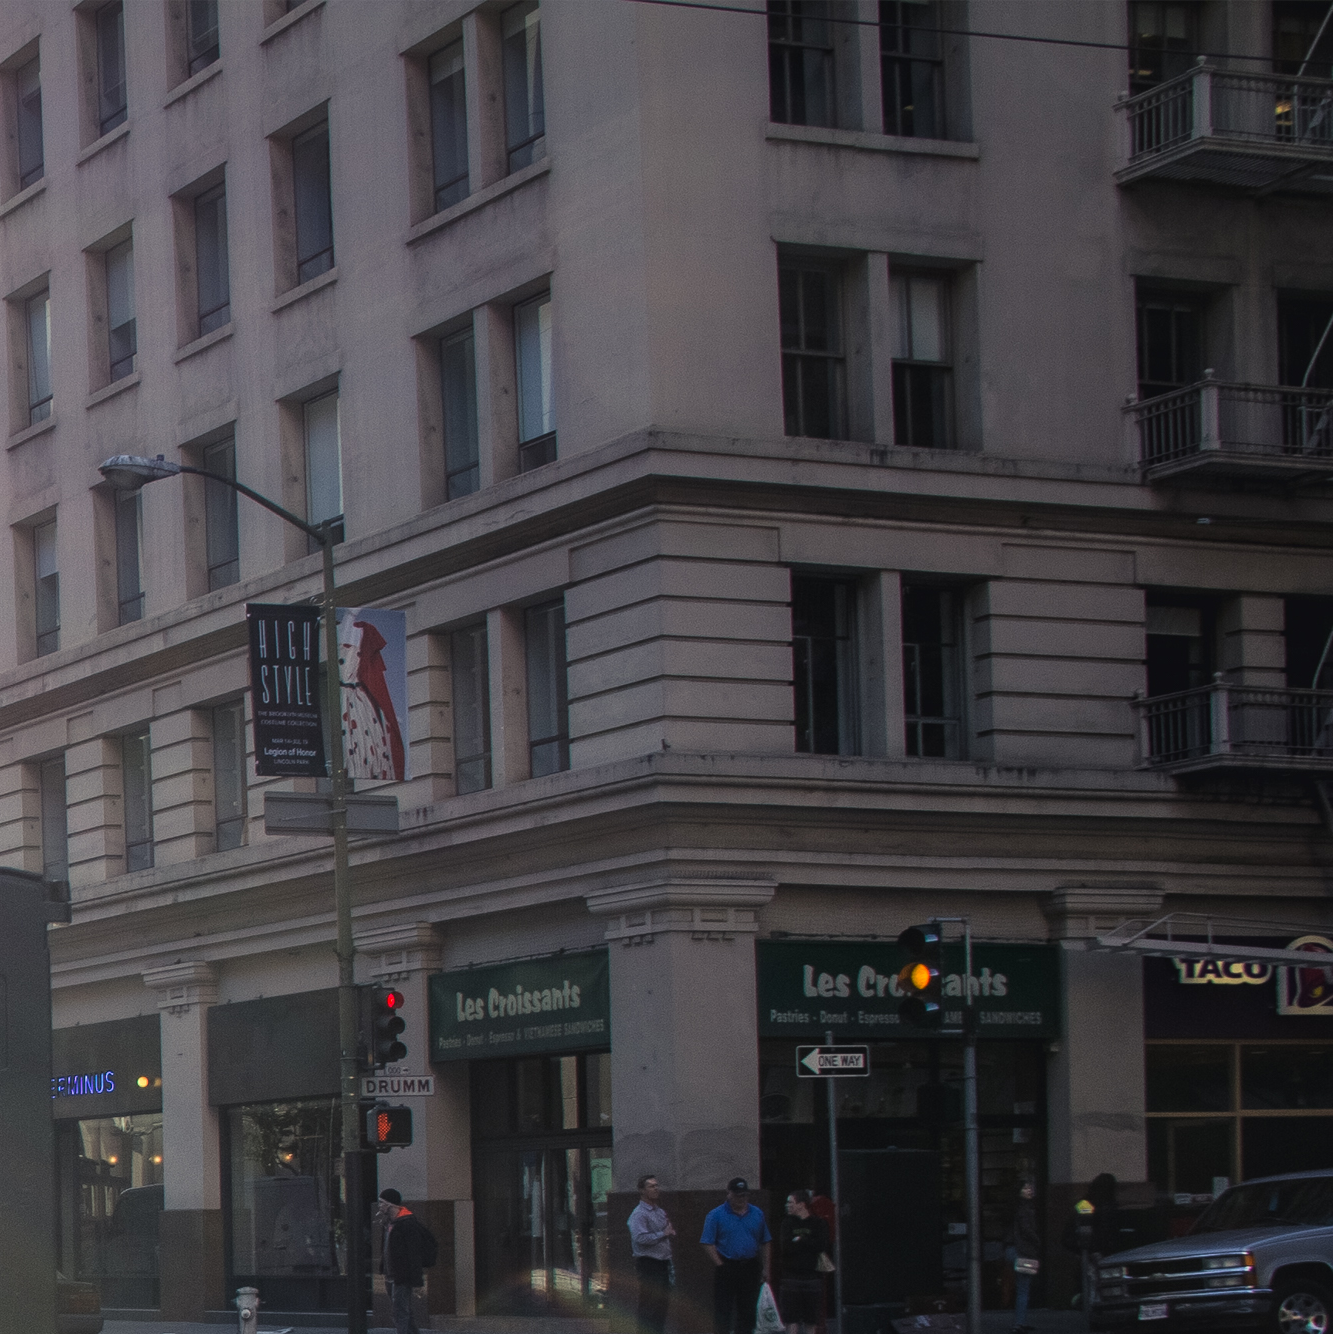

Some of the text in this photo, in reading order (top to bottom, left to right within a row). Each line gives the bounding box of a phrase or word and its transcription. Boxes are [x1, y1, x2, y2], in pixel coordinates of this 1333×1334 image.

[258, 619, 312, 661] HIGH
[260, 664, 313, 706] STYLE
[264, 747, 317, 757] Legion of Honor
[1176, 957, 1273, 985] TACO
[803, 964, 1008, 998] Les Croants
[455, 979, 581, 1022] Les Croissants
[770, 1009, 811, 1024] Pastries
[820, 1010, 849, 1024] Donut
[979, 1011, 1042, 1025] SANDWICHES
[564, 1018, 605, 1036] SANDWICHES
[818, 1055, 862, 1067] ONE WAY
[365, 1079, 431, 1094] DRUMM
